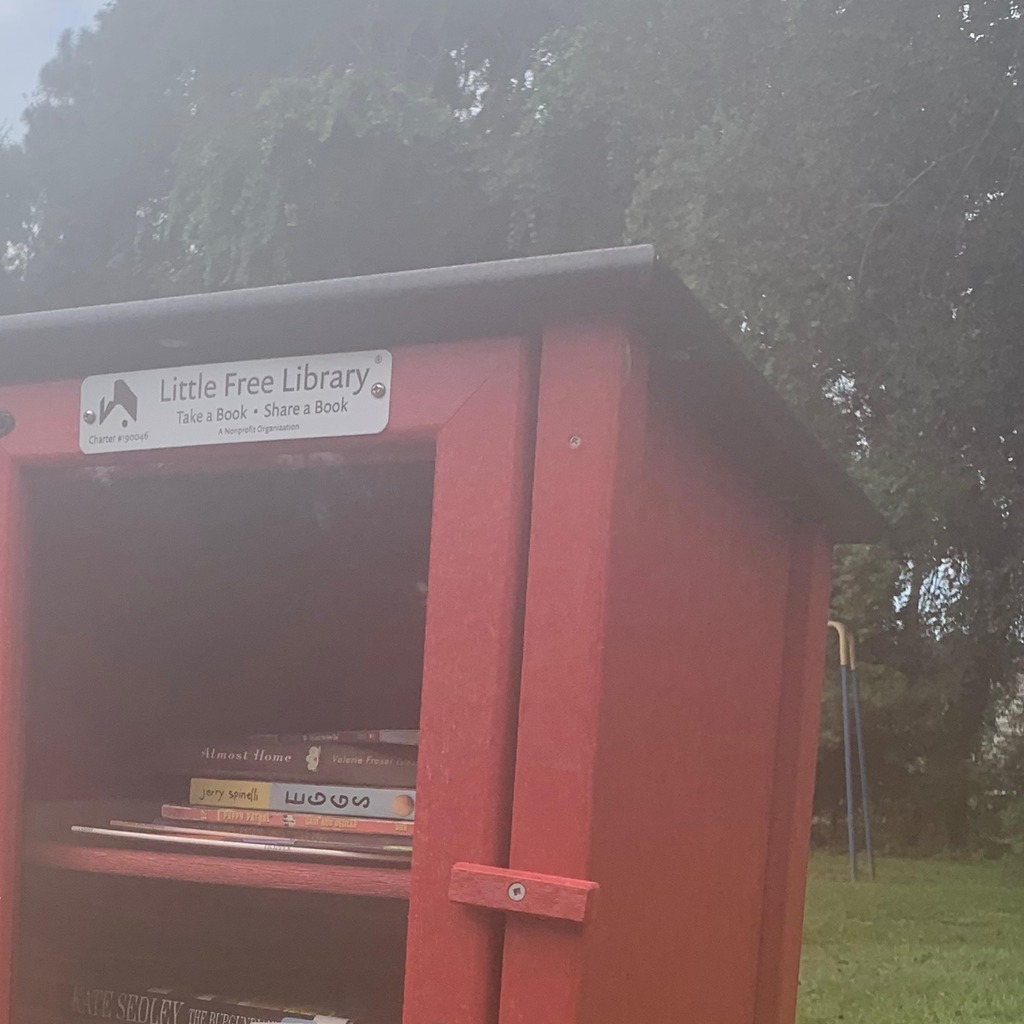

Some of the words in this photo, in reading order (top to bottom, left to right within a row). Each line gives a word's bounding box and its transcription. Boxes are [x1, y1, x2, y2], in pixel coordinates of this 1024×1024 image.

[160, 373, 216, 402] Little
[225, 371, 274, 397] Free
[282, 364, 370, 396] Library
[176, 409, 203, 425] Take
[206, 412, 213, 422] a
[217, 405, 247, 422] Book
[264, 401, 300, 418] Share
[303, 405, 310, 415] a
[315, 397, 348, 413] Book
[218, 428, 223, 436] A
[225, 425, 256, 436] Nonprofit
[257, 423, 300, 434] Organization
[88, 434, 116, 445] Charter
[200, 746, 249, 763] Almost
[253, 748, 292, 763] Home
[332, 755, 363, 765] Valerie
[200, 788, 225, 802] jerry
[228, 788, 259, 802] spinelli
[284, 790, 370, 809] EGGS
[72, 985, 113, 1019] KATE
